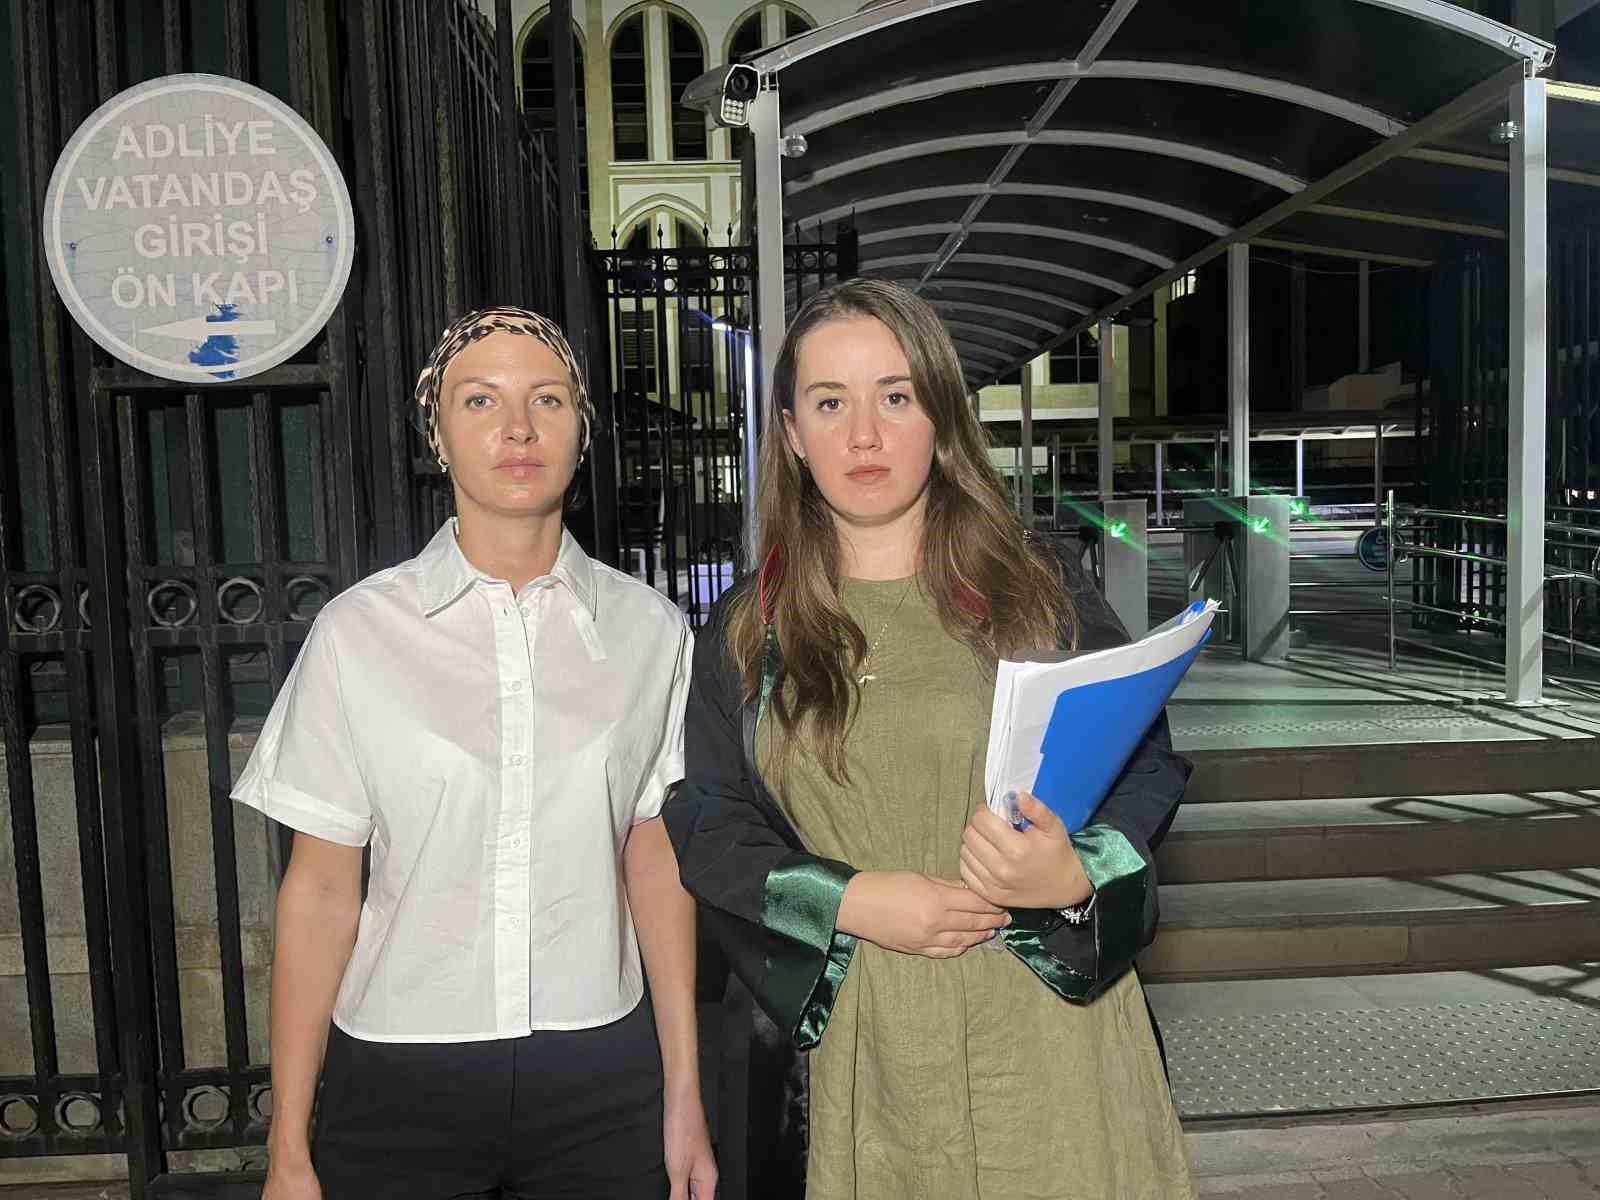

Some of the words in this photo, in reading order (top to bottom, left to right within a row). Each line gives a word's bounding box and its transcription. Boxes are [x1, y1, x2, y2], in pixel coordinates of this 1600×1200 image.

[112, 114, 277, 160] ADLİYE
[76, 169, 317, 212] VATANDAŞ
[133, 212, 268, 264] GİRİŞİ
[111, 266, 176, 309] ÖN
[192, 270, 298, 304] KAPI
